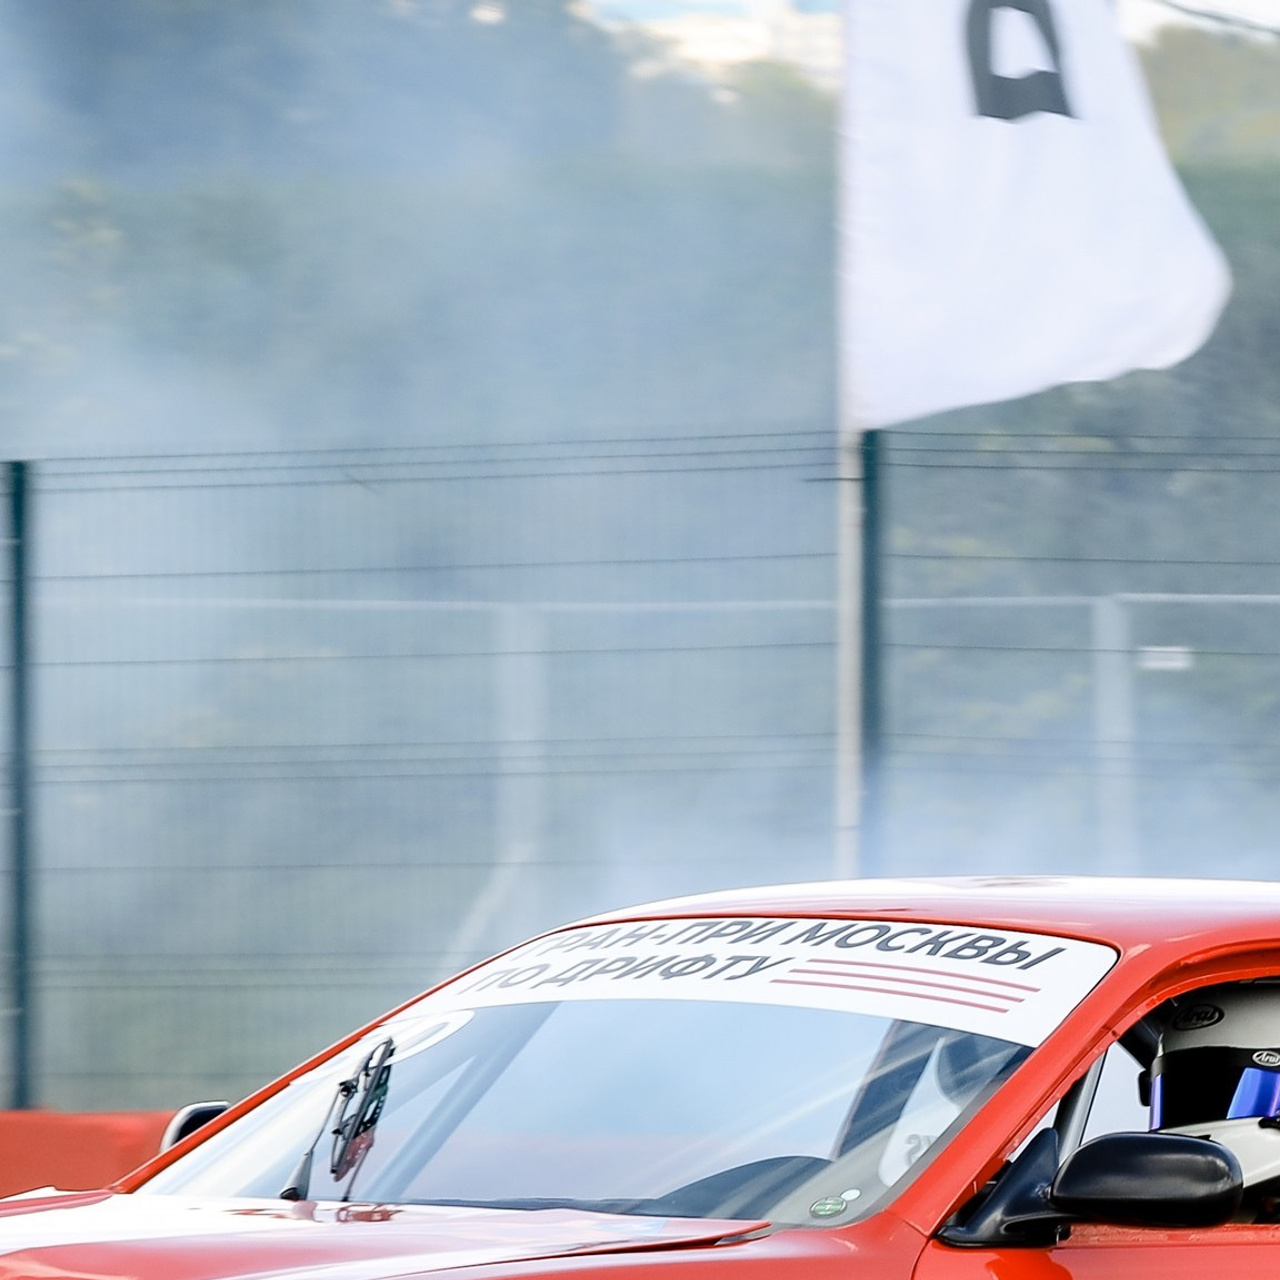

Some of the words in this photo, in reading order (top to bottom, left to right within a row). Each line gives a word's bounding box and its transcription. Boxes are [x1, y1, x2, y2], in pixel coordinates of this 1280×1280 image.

[510, 921, 797, 962] ГРАН-ПРИ
[779, 922, 1067, 970] МОСКВЫ
[457, 963, 550, 995] ПО
[529, 953, 796, 989] ДРИФТУ
